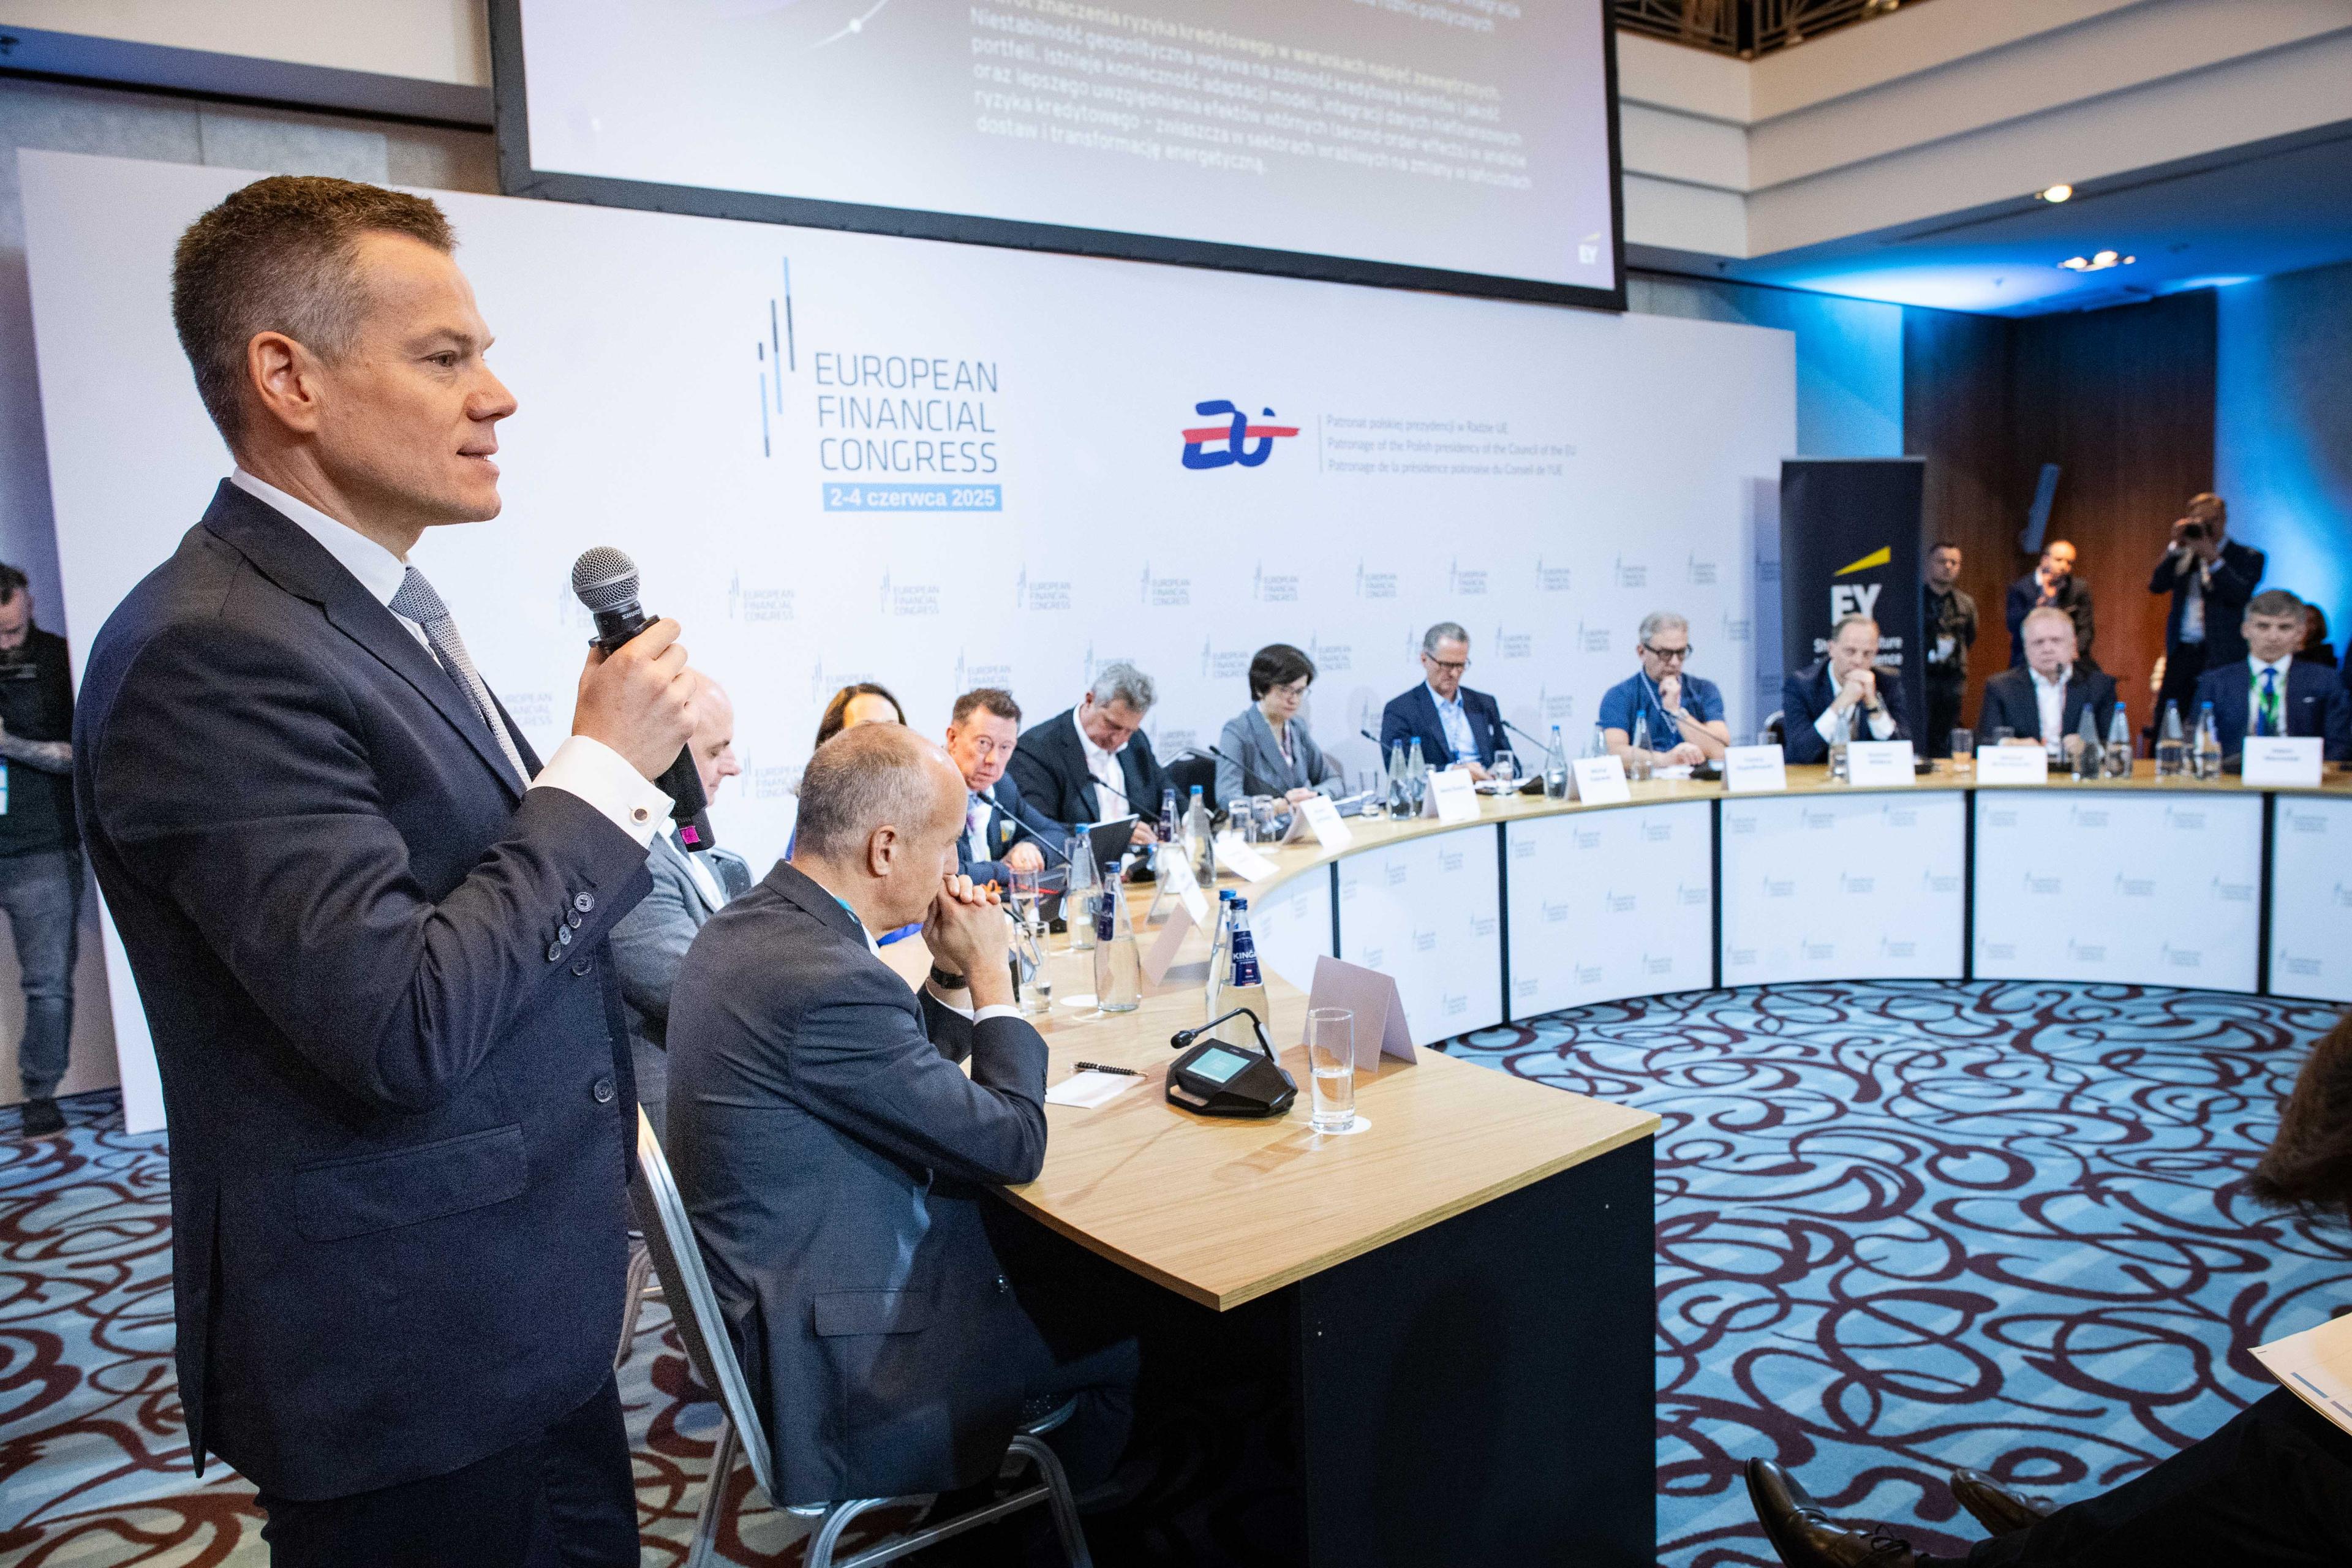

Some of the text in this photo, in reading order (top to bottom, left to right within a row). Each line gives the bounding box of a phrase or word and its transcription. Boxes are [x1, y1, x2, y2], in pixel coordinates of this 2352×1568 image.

[1123, 14, 1177, 37] ryzyka
[1179, 23, 1275, 58] kredytowego
[971, 6, 1082, 45] Niestabilność
[1085, 31, 1193, 65] geopolityczna
[1251, 64, 1270, 80] na
[971, 37, 1041, 62] portfeli.
[1105, 58, 1200, 90] konieczność
[973, 62, 1011, 84] oraz
[1016, 67, 1090, 99] lepszego
[974, 89, 1032, 113] ryzyka
[1035, 96, 1140, 132] kredytowego
[976, 113, 1038, 139] dostaw
[815, 352, 998, 393] EUROPEAN
[818, 395, 996, 433] FINANCIAL
[1327, 437, 1374, 453] Patronage
[1389, 440, 1404, 451] the
[820, 437, 998, 473] CONGRESS
[1328, 458, 1375, 475] Patronage
[830, 488, 996, 508] 2-4 czerwca 2025
[1030, 582, 1071, 590] EUROPEAN
[1152, 578, 1191, 587] EUROPEAN
[743, 589, 795, 600] EUROPEAN
[893, 585, 940, 595] EUROPEAN
[1030, 592, 1069, 600] FINANCIAL
[744, 600, 793, 610] FINANCIAL
[894, 596, 938, 605] FINANCIAL
[1030, 601, 1071, 611] CONGRESS
[1831, 584, 1883, 625] EY
[622, 608, 642, 620] SHURE
[745, 610, 795, 622] CONGRESS
[894, 606, 940, 616] CONGRESS
[967, 665, 1012, 674] EUROPEAN
[826, 673, 874, 685] EUROPEAN
[968, 675, 1009, 684] FINANCIAL
